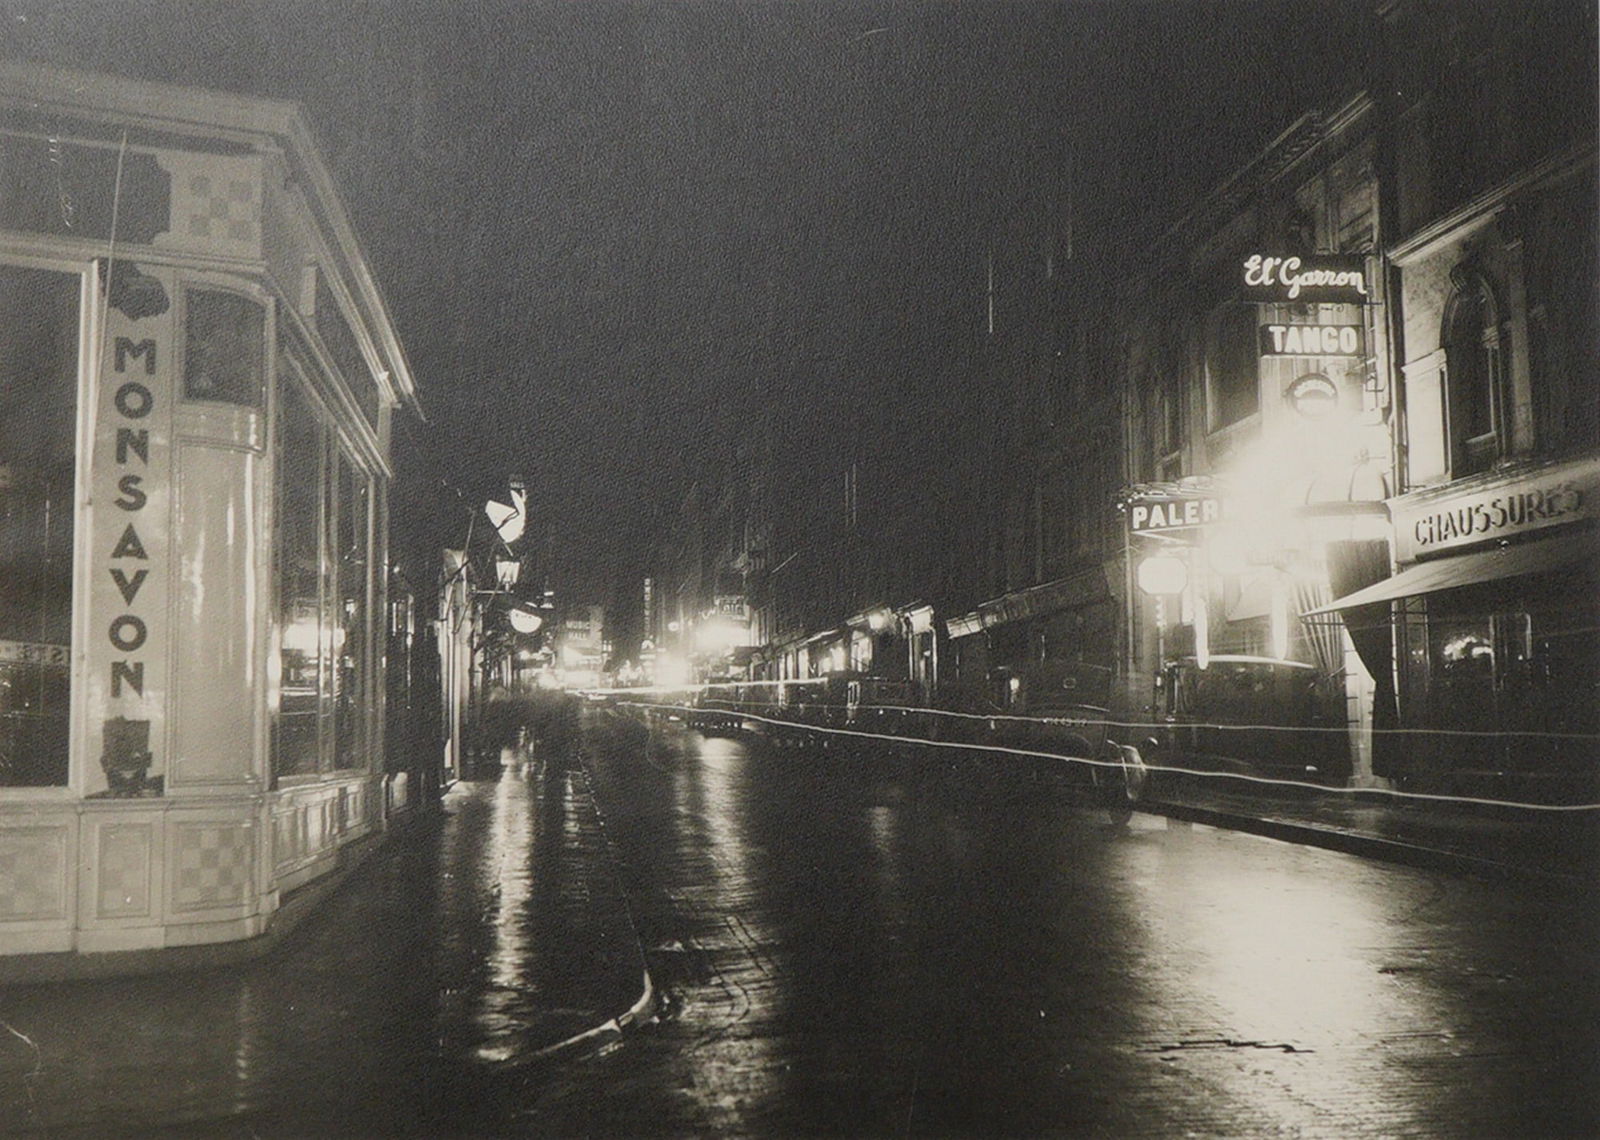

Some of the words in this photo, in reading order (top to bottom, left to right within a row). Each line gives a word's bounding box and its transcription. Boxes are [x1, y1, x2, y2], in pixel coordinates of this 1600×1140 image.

[1268, 325, 1358, 354] TANGO
[108, 336, 157, 699] MONSAVON
[1415, 482, 1583, 545] CHAUSSURES
